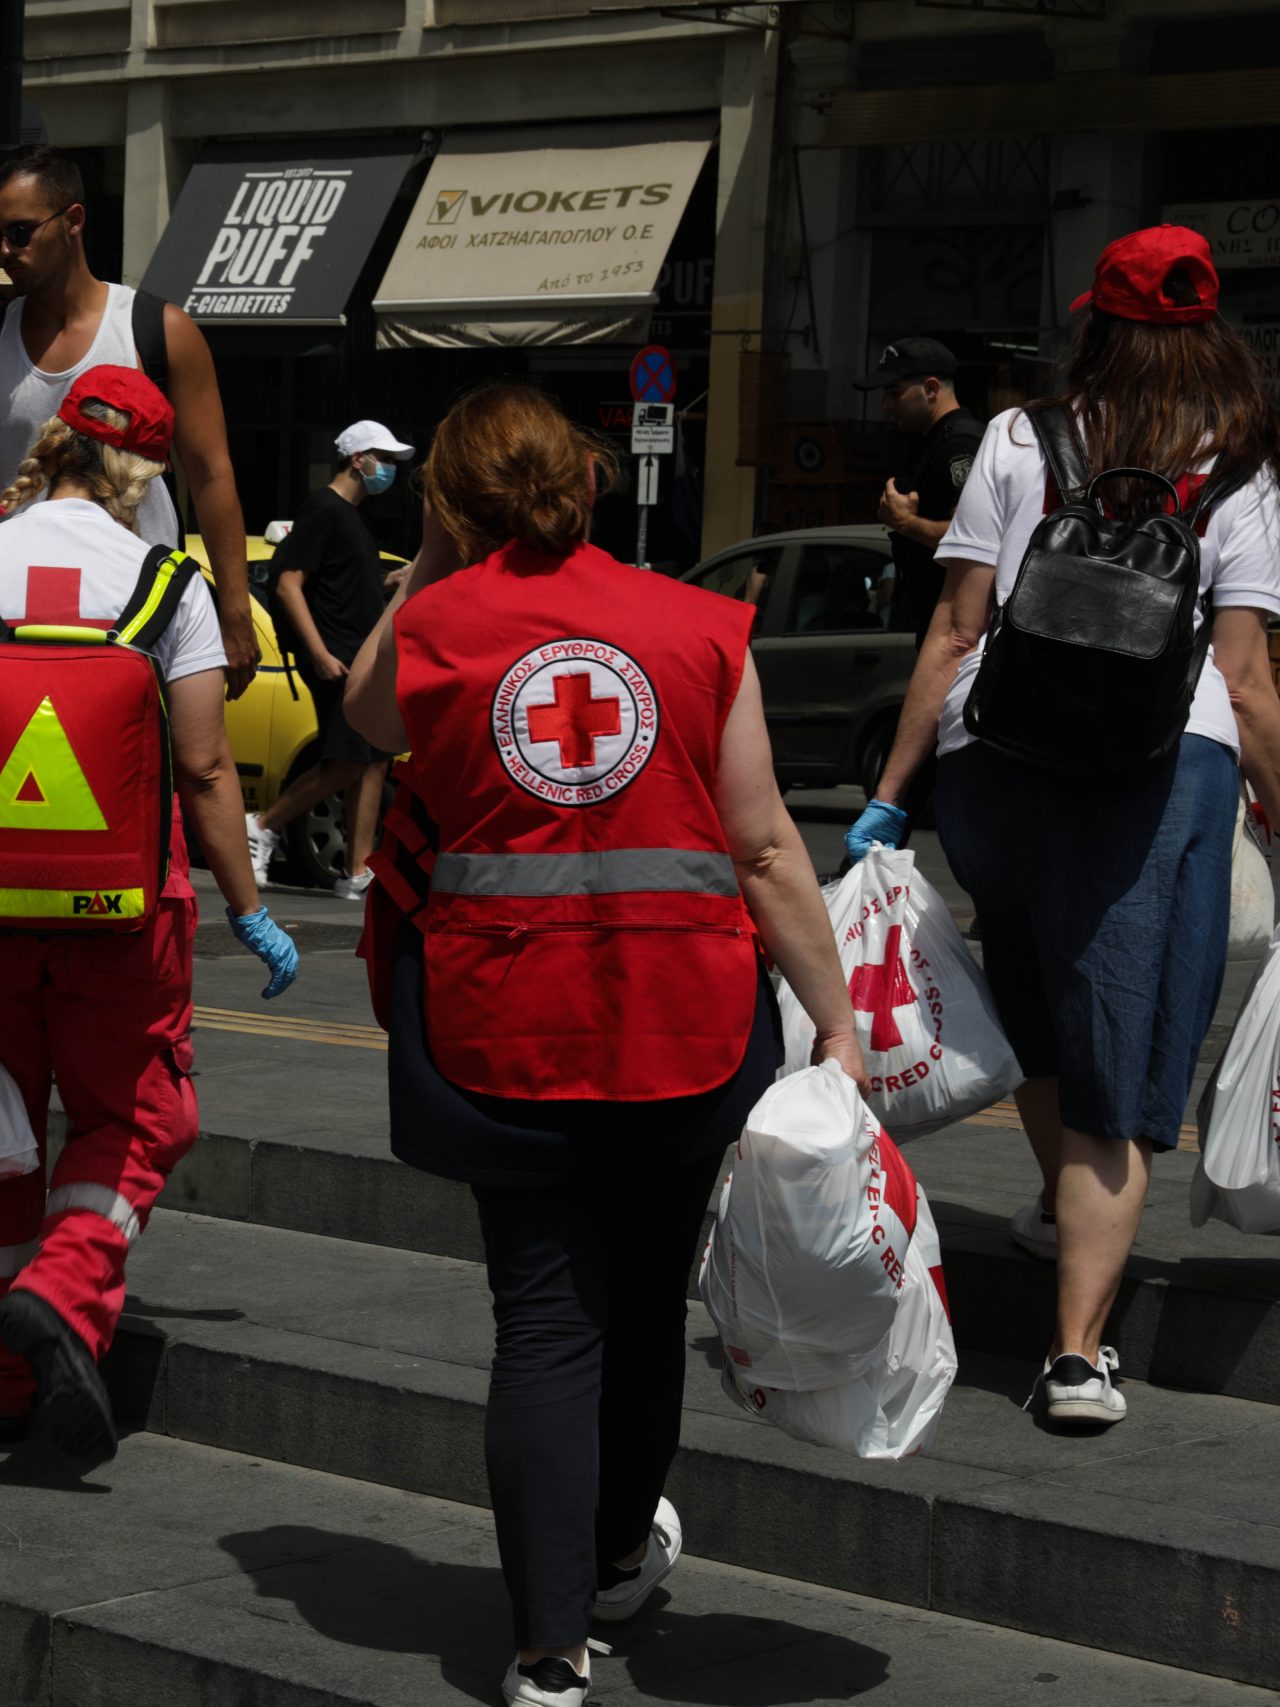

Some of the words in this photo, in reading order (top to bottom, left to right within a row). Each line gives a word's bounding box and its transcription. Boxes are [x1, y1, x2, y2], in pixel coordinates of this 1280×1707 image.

[223, 179, 347, 227] LIQUID
[469, 183, 673, 216] VIOKETS
[416, 234, 458, 250] ΑΦΟΙ
[465, 226, 617, 248] ΧΑΤΖΗΑΓΑΠΟΓΛΟΥ
[196, 225, 327, 285] PUFF
[599, 260, 644, 281] 1953
[183, 294, 292, 315] E-CIGARETTES
[495, 658, 538, 748] ΕΛΛΗΝΙΚΟΣ
[539, 643, 619, 665] ΕΡΥΘΡΟΣ
[618, 662, 654, 731] ΣΤΑΥΡΟΣ
[507, 756, 574, 802] HELLENIC
[576, 783, 604, 801] RED
[605, 743, 648, 790] CROSS
[73, 890, 122, 915] PAX
[885, 1061, 930, 1093] RED
